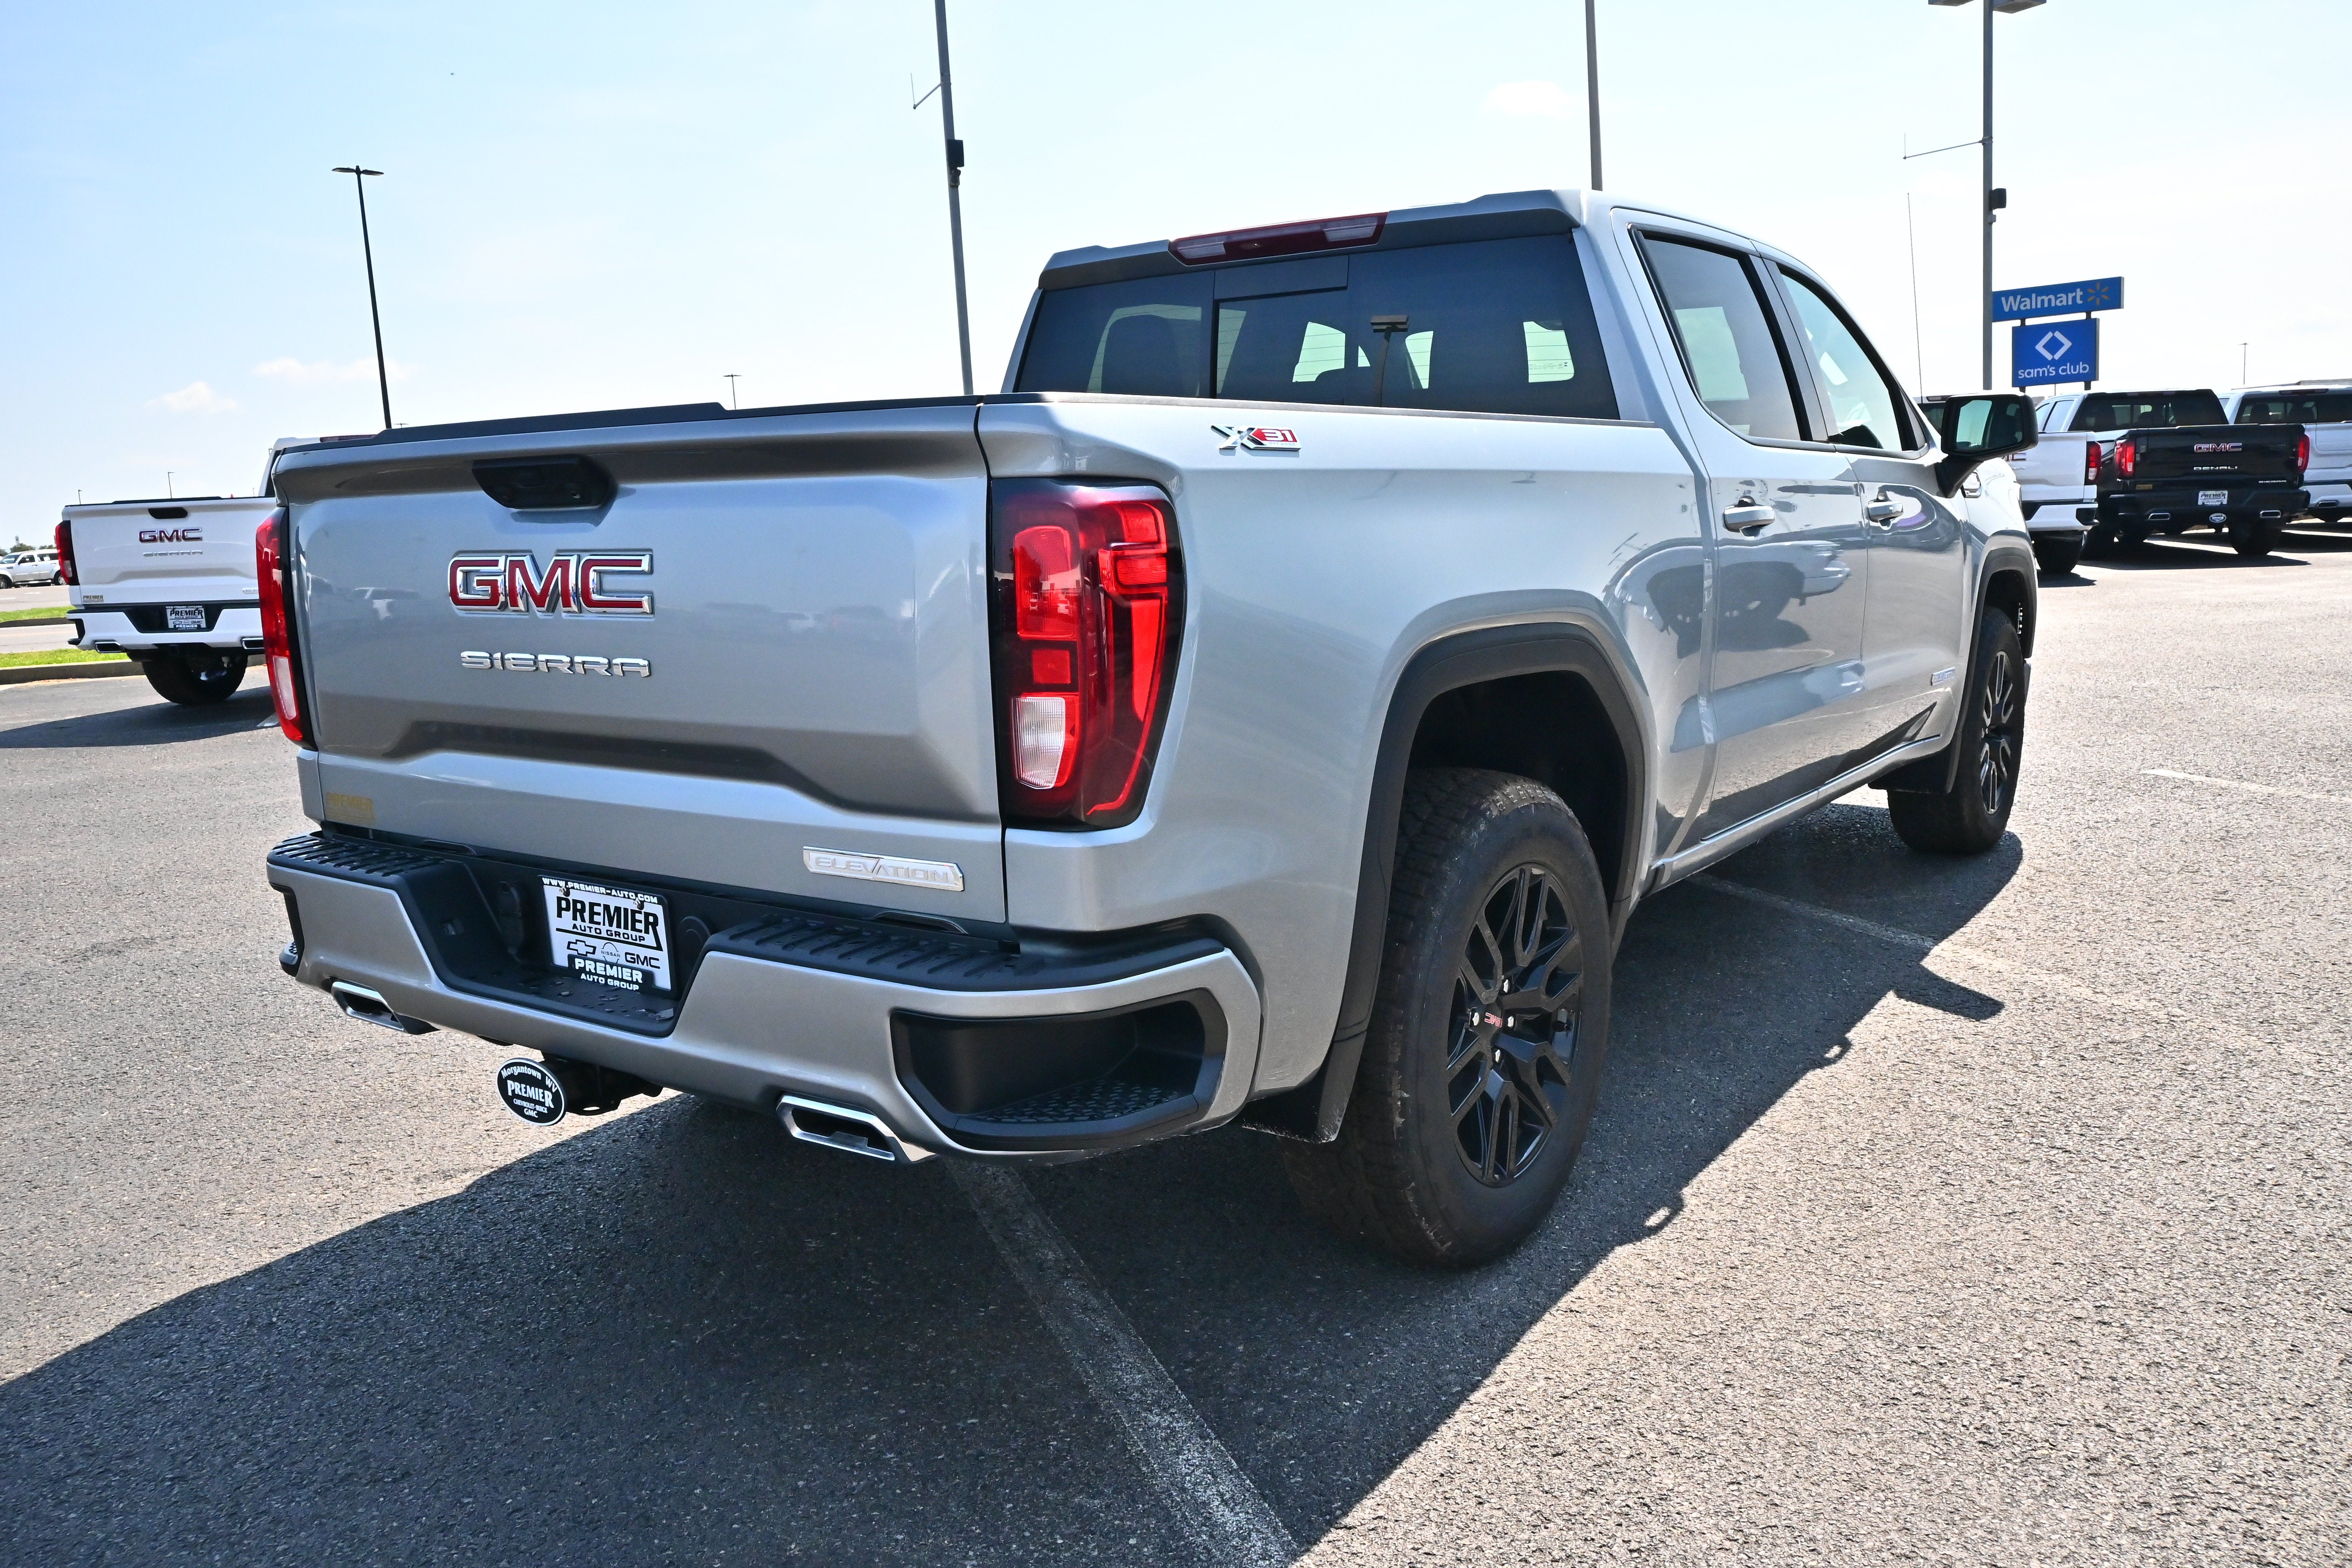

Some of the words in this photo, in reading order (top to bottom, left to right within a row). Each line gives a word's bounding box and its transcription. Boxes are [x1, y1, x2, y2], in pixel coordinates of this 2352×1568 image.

[2001, 288, 2083, 312] Walmart
[2018, 365, 2055, 379] sam's
[2059, 362, 2089, 374] club
[2194, 443, 2242, 452] GMC
[139, 528, 203, 543] GMC
[448, 554, 653, 614] GMC
[170, 610, 203, 618] PREMIER
[460, 651, 651, 678] SIERRA
[815, 856, 949, 883] ELEVATION
[542, 877, 658, 904] WWW.PREMIER-AUTO.COM
[556, 896, 662, 945] PREMIER
[572, 923, 602, 935] AUTO
[606, 930, 645, 943] GROUP
[601, 950, 621, 958] NISSAN
[625, 952, 660, 969] GMC
[574, 958, 642, 983] PREMIER
[580, 973, 605, 984] AUTO
[607, 979, 639, 991] GROUP
[501, 1065, 542, 1080] Morgantown
[545, 1076, 558, 1093] WV
[507, 1080, 554, 1108] PREMIER
[524, 1108, 538, 1118] GMC
